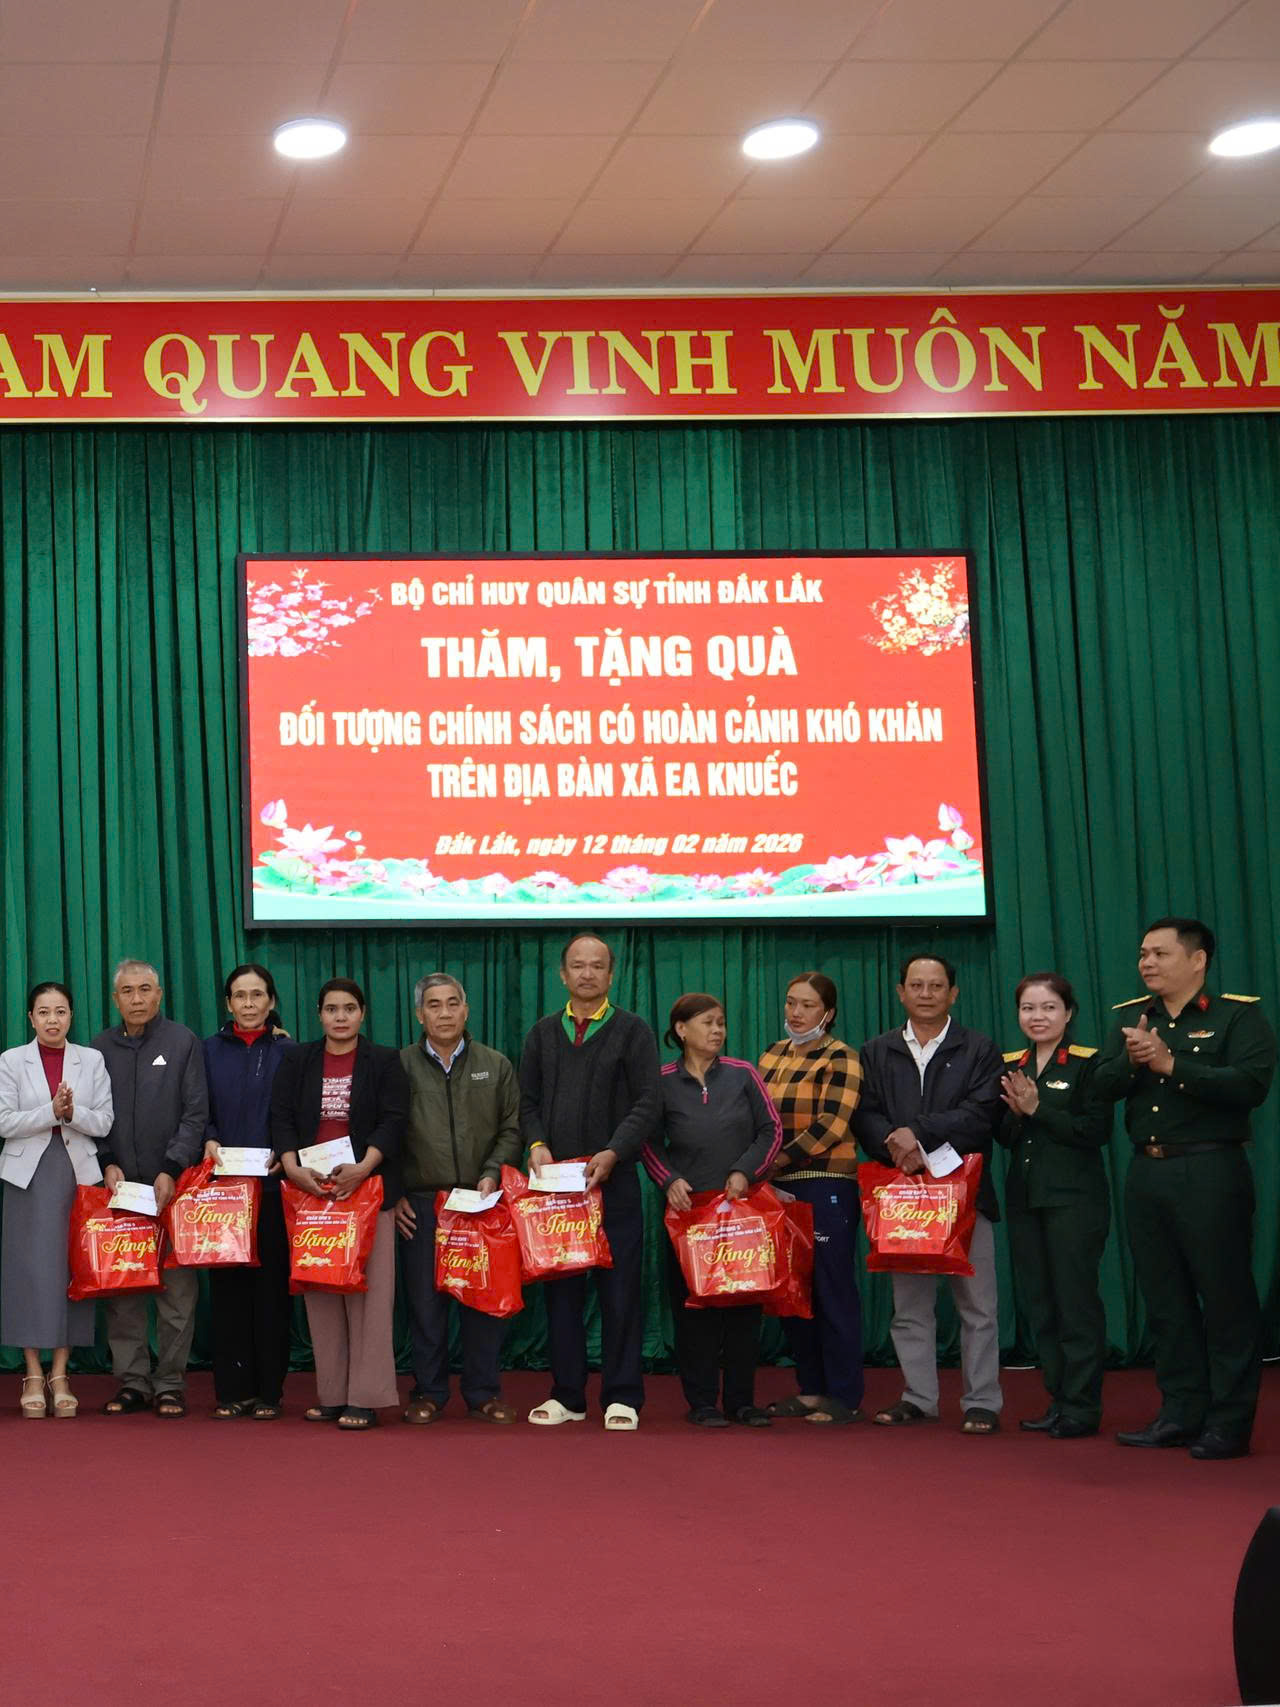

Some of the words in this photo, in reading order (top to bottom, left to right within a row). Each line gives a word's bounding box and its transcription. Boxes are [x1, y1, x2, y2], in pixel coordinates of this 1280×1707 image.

[142, 331, 475, 415] QUANG
[497, 330, 738, 397] VINH
[763, 307, 1047, 395] MUÔN
[1073, 303, 1280, 390] NĂM
[391, 577, 425, 611] BỘ
[432, 573, 474, 606] CHỈ
[481, 581, 530, 606] HUY
[536, 576, 606, 607] QUÂN
[613, 578, 650, 609] SỰ
[653, 572, 711, 605] TỈNH
[717, 572, 769, 604] ĐẮK
[775, 572, 824, 603] LẮK
[420, 628, 561, 683] THĂM,
[573, 627, 693, 687] TẶNG
[706, 626, 798, 681] QUÀ
[279, 699, 325, 746] ĐỐI
[332, 707, 422, 753] TƯỢNG
[428, 703, 512, 746] CHÍNH
[519, 703, 592, 745] SÁCH
[599, 702, 636, 745] CÓ
[642, 702, 718, 745] HOÀN
[724, 695, 800, 744] CẢNH
[805, 701, 861, 743] KHÓ
[868, 701, 943, 743] KHĂN
[426, 756, 497, 798] TRÊN
[503, 763, 551, 806] ĐỊA
[557, 755, 614, 798] BÀN
[621, 755, 659, 797] XÃ
[665, 762, 701, 797] EA
[707, 750, 799, 797] KNUẾC
[435, 831, 476, 855] Đắk
[479, 831, 521, 857] Lắk,
[526, 833, 577, 857] ngày
[582, 834, 609, 855] 12
[610, 833, 669, 856] tháng
[671, 833, 700, 855] 02
[702, 832, 749, 854] năm
[750, 833, 804, 854] 2026
